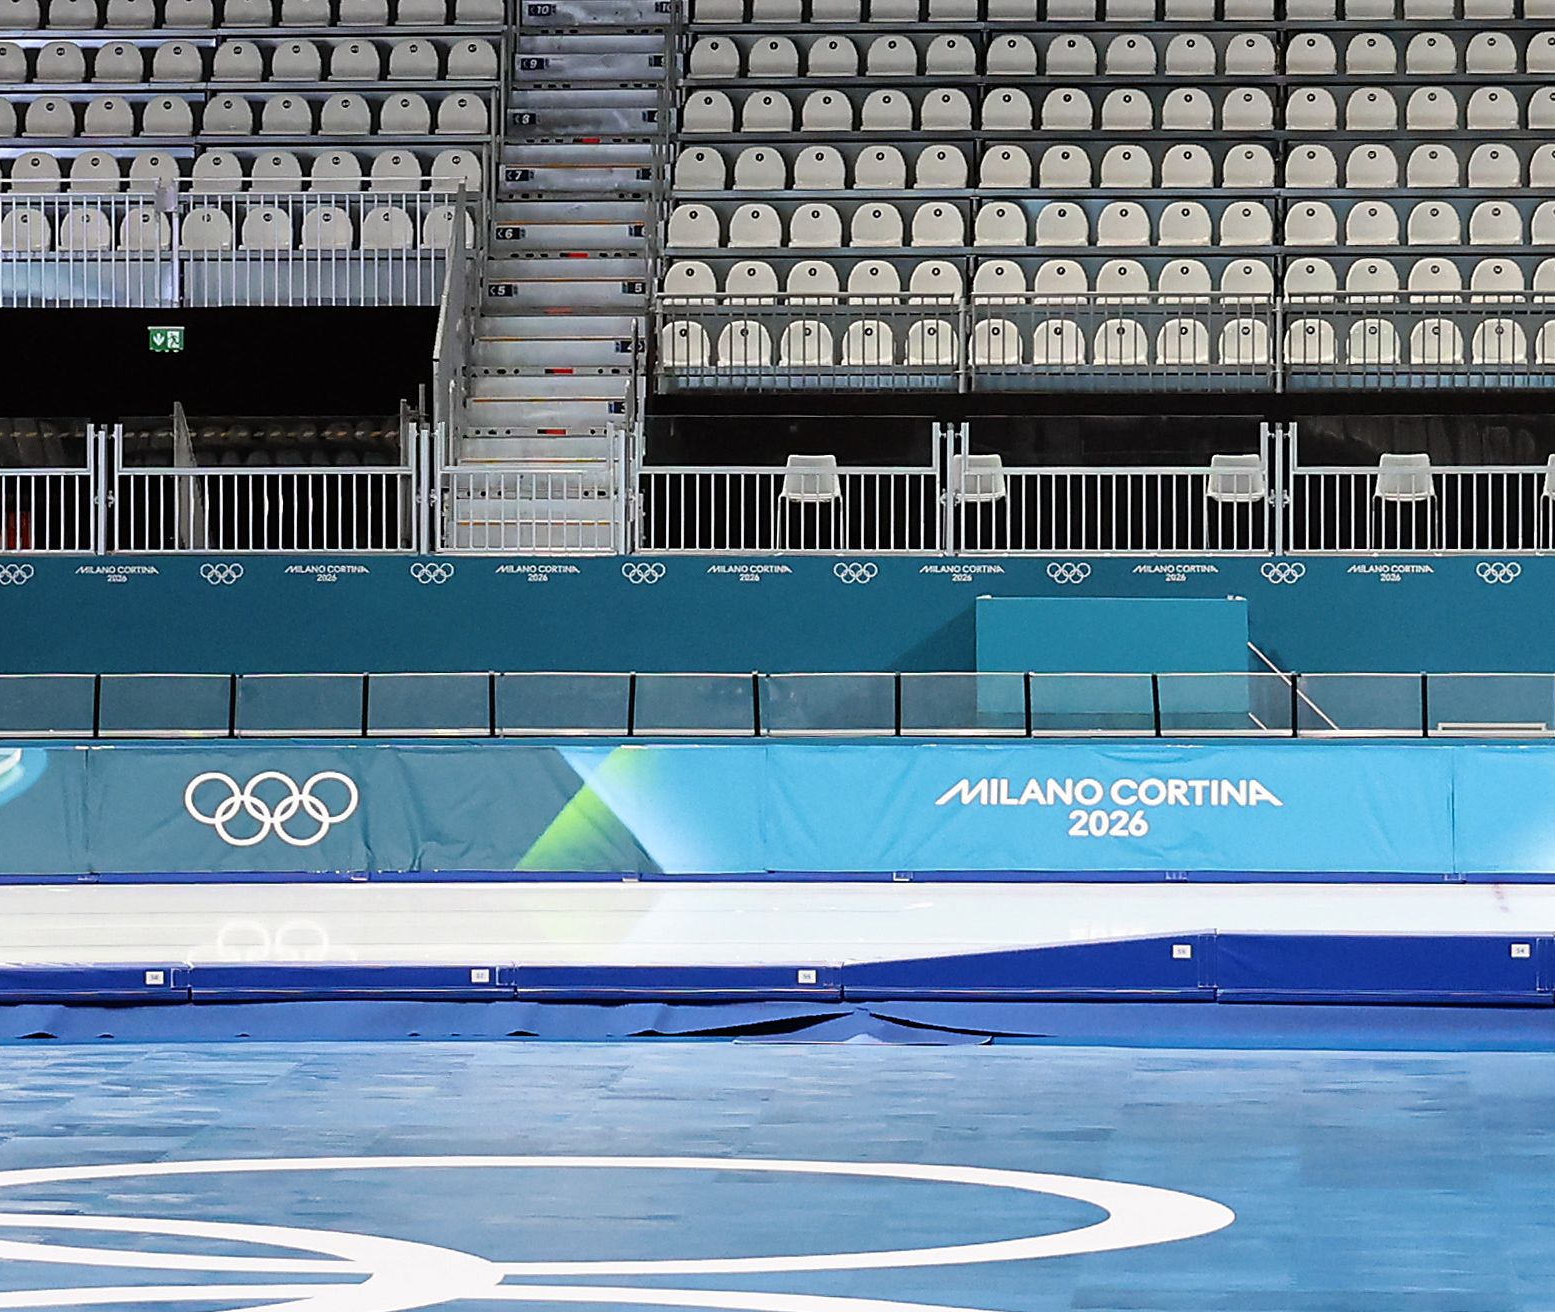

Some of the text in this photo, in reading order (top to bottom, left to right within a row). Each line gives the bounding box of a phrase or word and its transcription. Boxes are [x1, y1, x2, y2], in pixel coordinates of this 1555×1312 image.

[537, 5, 549, 15] 10
[515, 171, 522, 180] 7
[505, 229, 513, 238] 6
[497, 286, 505, 294] 5
[635, 284, 642, 292] 5
[76, 565, 158, 575] MILANO CORTINA
[285, 564, 369, 574] MILANO CORTINA
[496, 564, 580, 574] MILANO CORTINA
[707, 564, 792, 574] MILANO CORTINA
[920, 564, 1004, 574] MILANO CORTINA
[1133, 564, 1218, 574] MILANO CORTINA
[1348, 564, 1434, 573] MILANO CORTINA
[107, 574, 127, 583] 2026
[317, 573, 337, 582] 2026
[528, 573, 548, 582] 2026
[740, 573, 759, 582] 2026
[952, 573, 972, 582] 2026
[1166, 572, 1186, 582] 2026
[1381, 572, 1401, 582] 2026
[936, 778, 1283, 806] MILANO CORTINA
[1069, 810, 1148, 836] 2026
